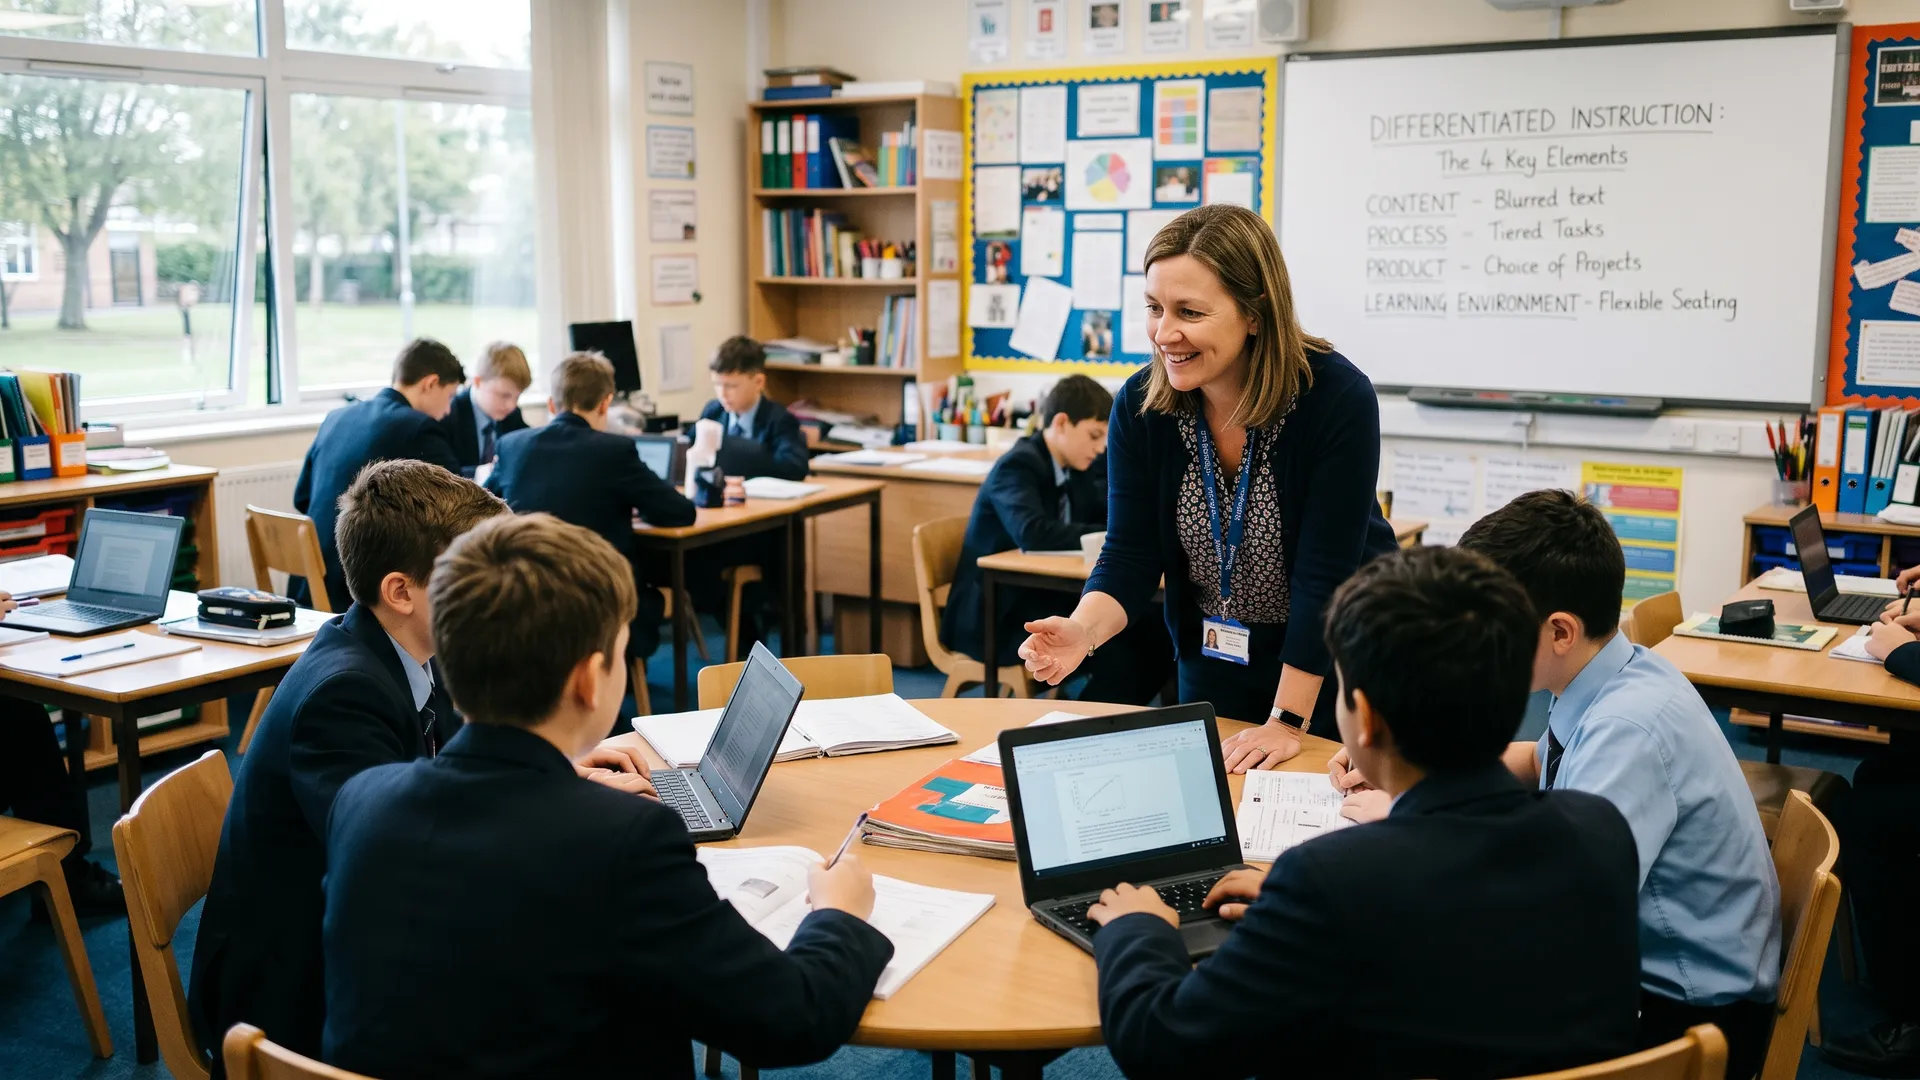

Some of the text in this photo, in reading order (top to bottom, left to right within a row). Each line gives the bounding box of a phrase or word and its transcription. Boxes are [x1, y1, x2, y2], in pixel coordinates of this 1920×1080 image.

[1370, 102, 1725, 142] DIFFERENTIATED INSTRUCTION:
[1435, 144, 1629, 179] The 4 Key Elements
[1365, 192, 1461, 215] CONTENT
[1494, 187, 1559, 211] Blurred
[1569, 184, 1606, 207] text
[1366, 224, 1448, 246] PROCESS
[1488, 219, 1545, 242] Tiered
[1553, 216, 1605, 239] Tasks
[1365, 258, 1447, 279] PRODUCT
[1484, 253, 1540, 276] Choice
[1547, 252, 1568, 281] of
[1575, 250, 1642, 281] Projects
[1364, 292, 1448, 313] LEARNING
[1599, 289, 1664, 312] Flexible
[1671, 286, 1738, 323] Seating
